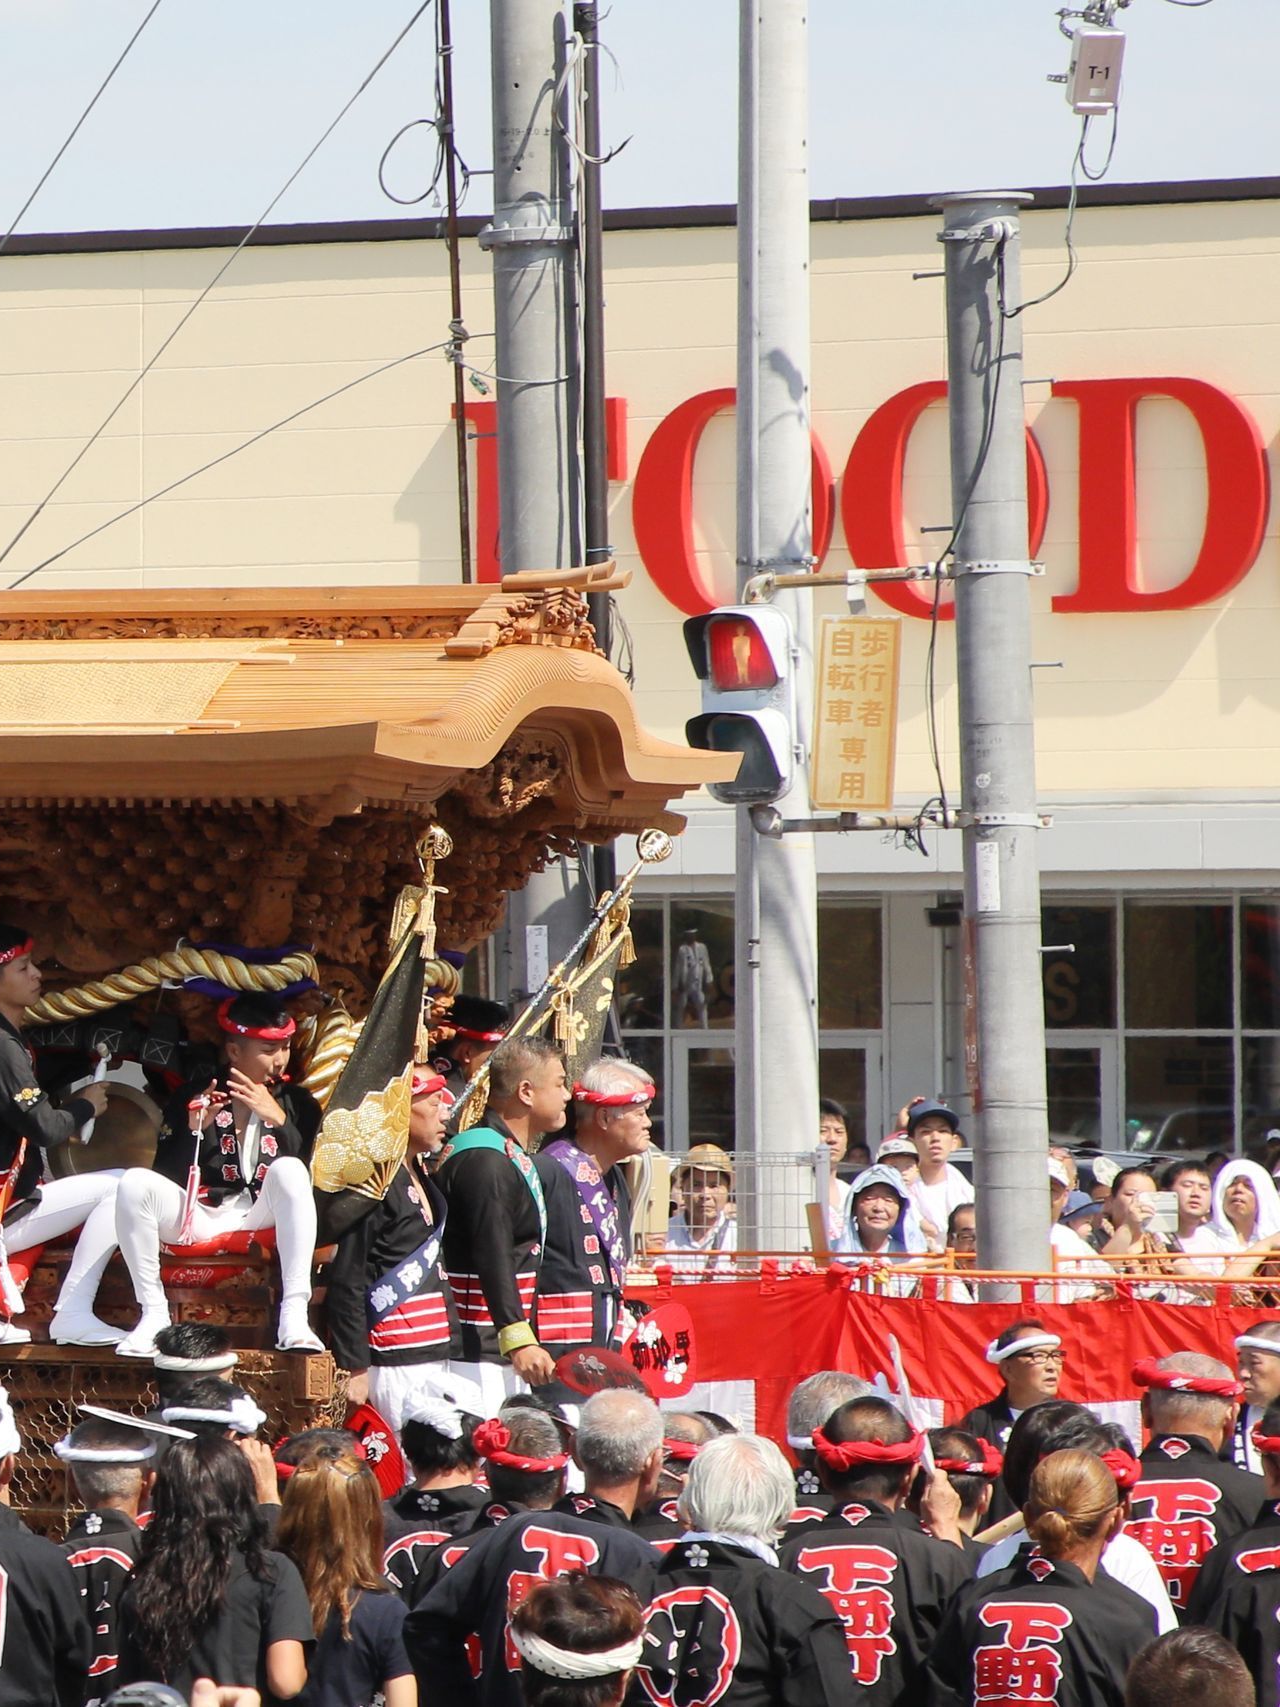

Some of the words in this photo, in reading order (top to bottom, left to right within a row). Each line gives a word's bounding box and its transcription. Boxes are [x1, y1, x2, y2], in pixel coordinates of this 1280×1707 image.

[1089, 66, 1110, 80] T-1
[825, 628, 857, 726] 自転車
[856, 630, 890, 728] 歩行者
[837, 737, 868, 800] 専用
[973, 1601, 1074, 1707] 下野
